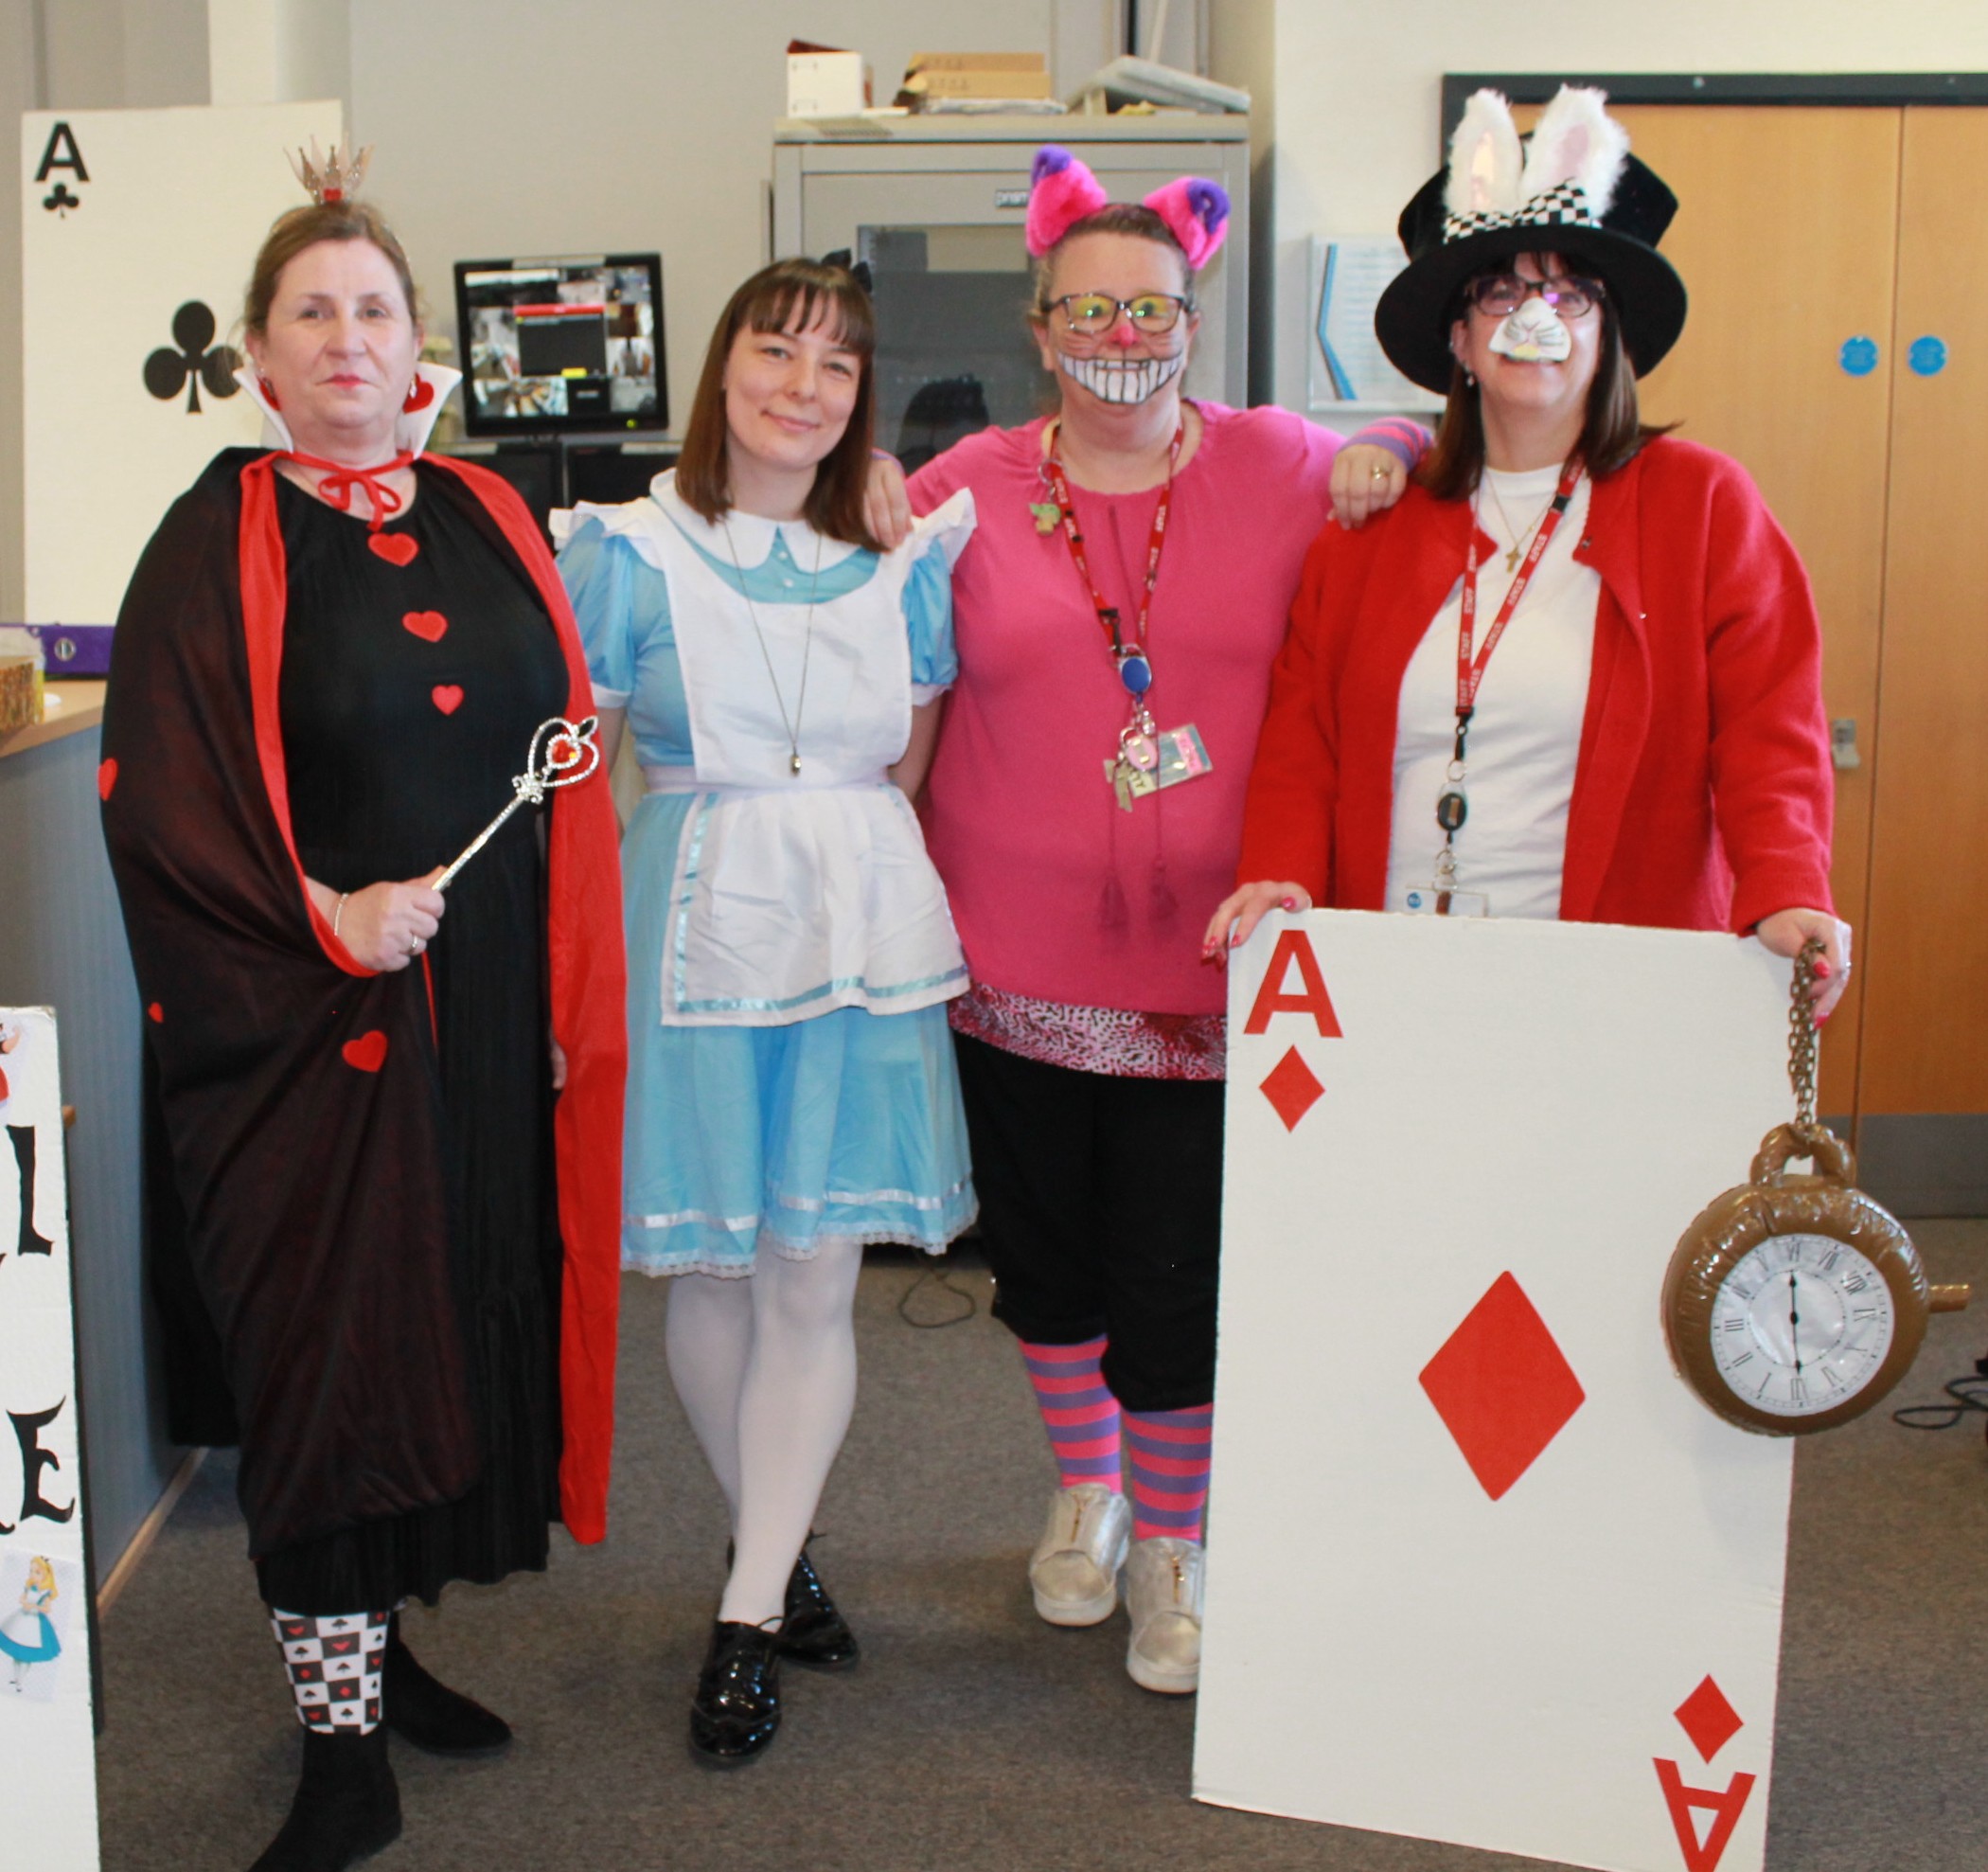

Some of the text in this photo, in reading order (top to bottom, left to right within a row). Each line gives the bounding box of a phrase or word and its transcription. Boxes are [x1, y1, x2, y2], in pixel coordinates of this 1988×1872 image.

[34, 121, 90, 182] A
[1244, 929, 1343, 1039] A
[1724, 1318, 1745, 1332] III
[1731, 1351, 1753, 1368] II
[0, 1395, 76, 1535] E
[1652, 1756, 1757, 1872] A
